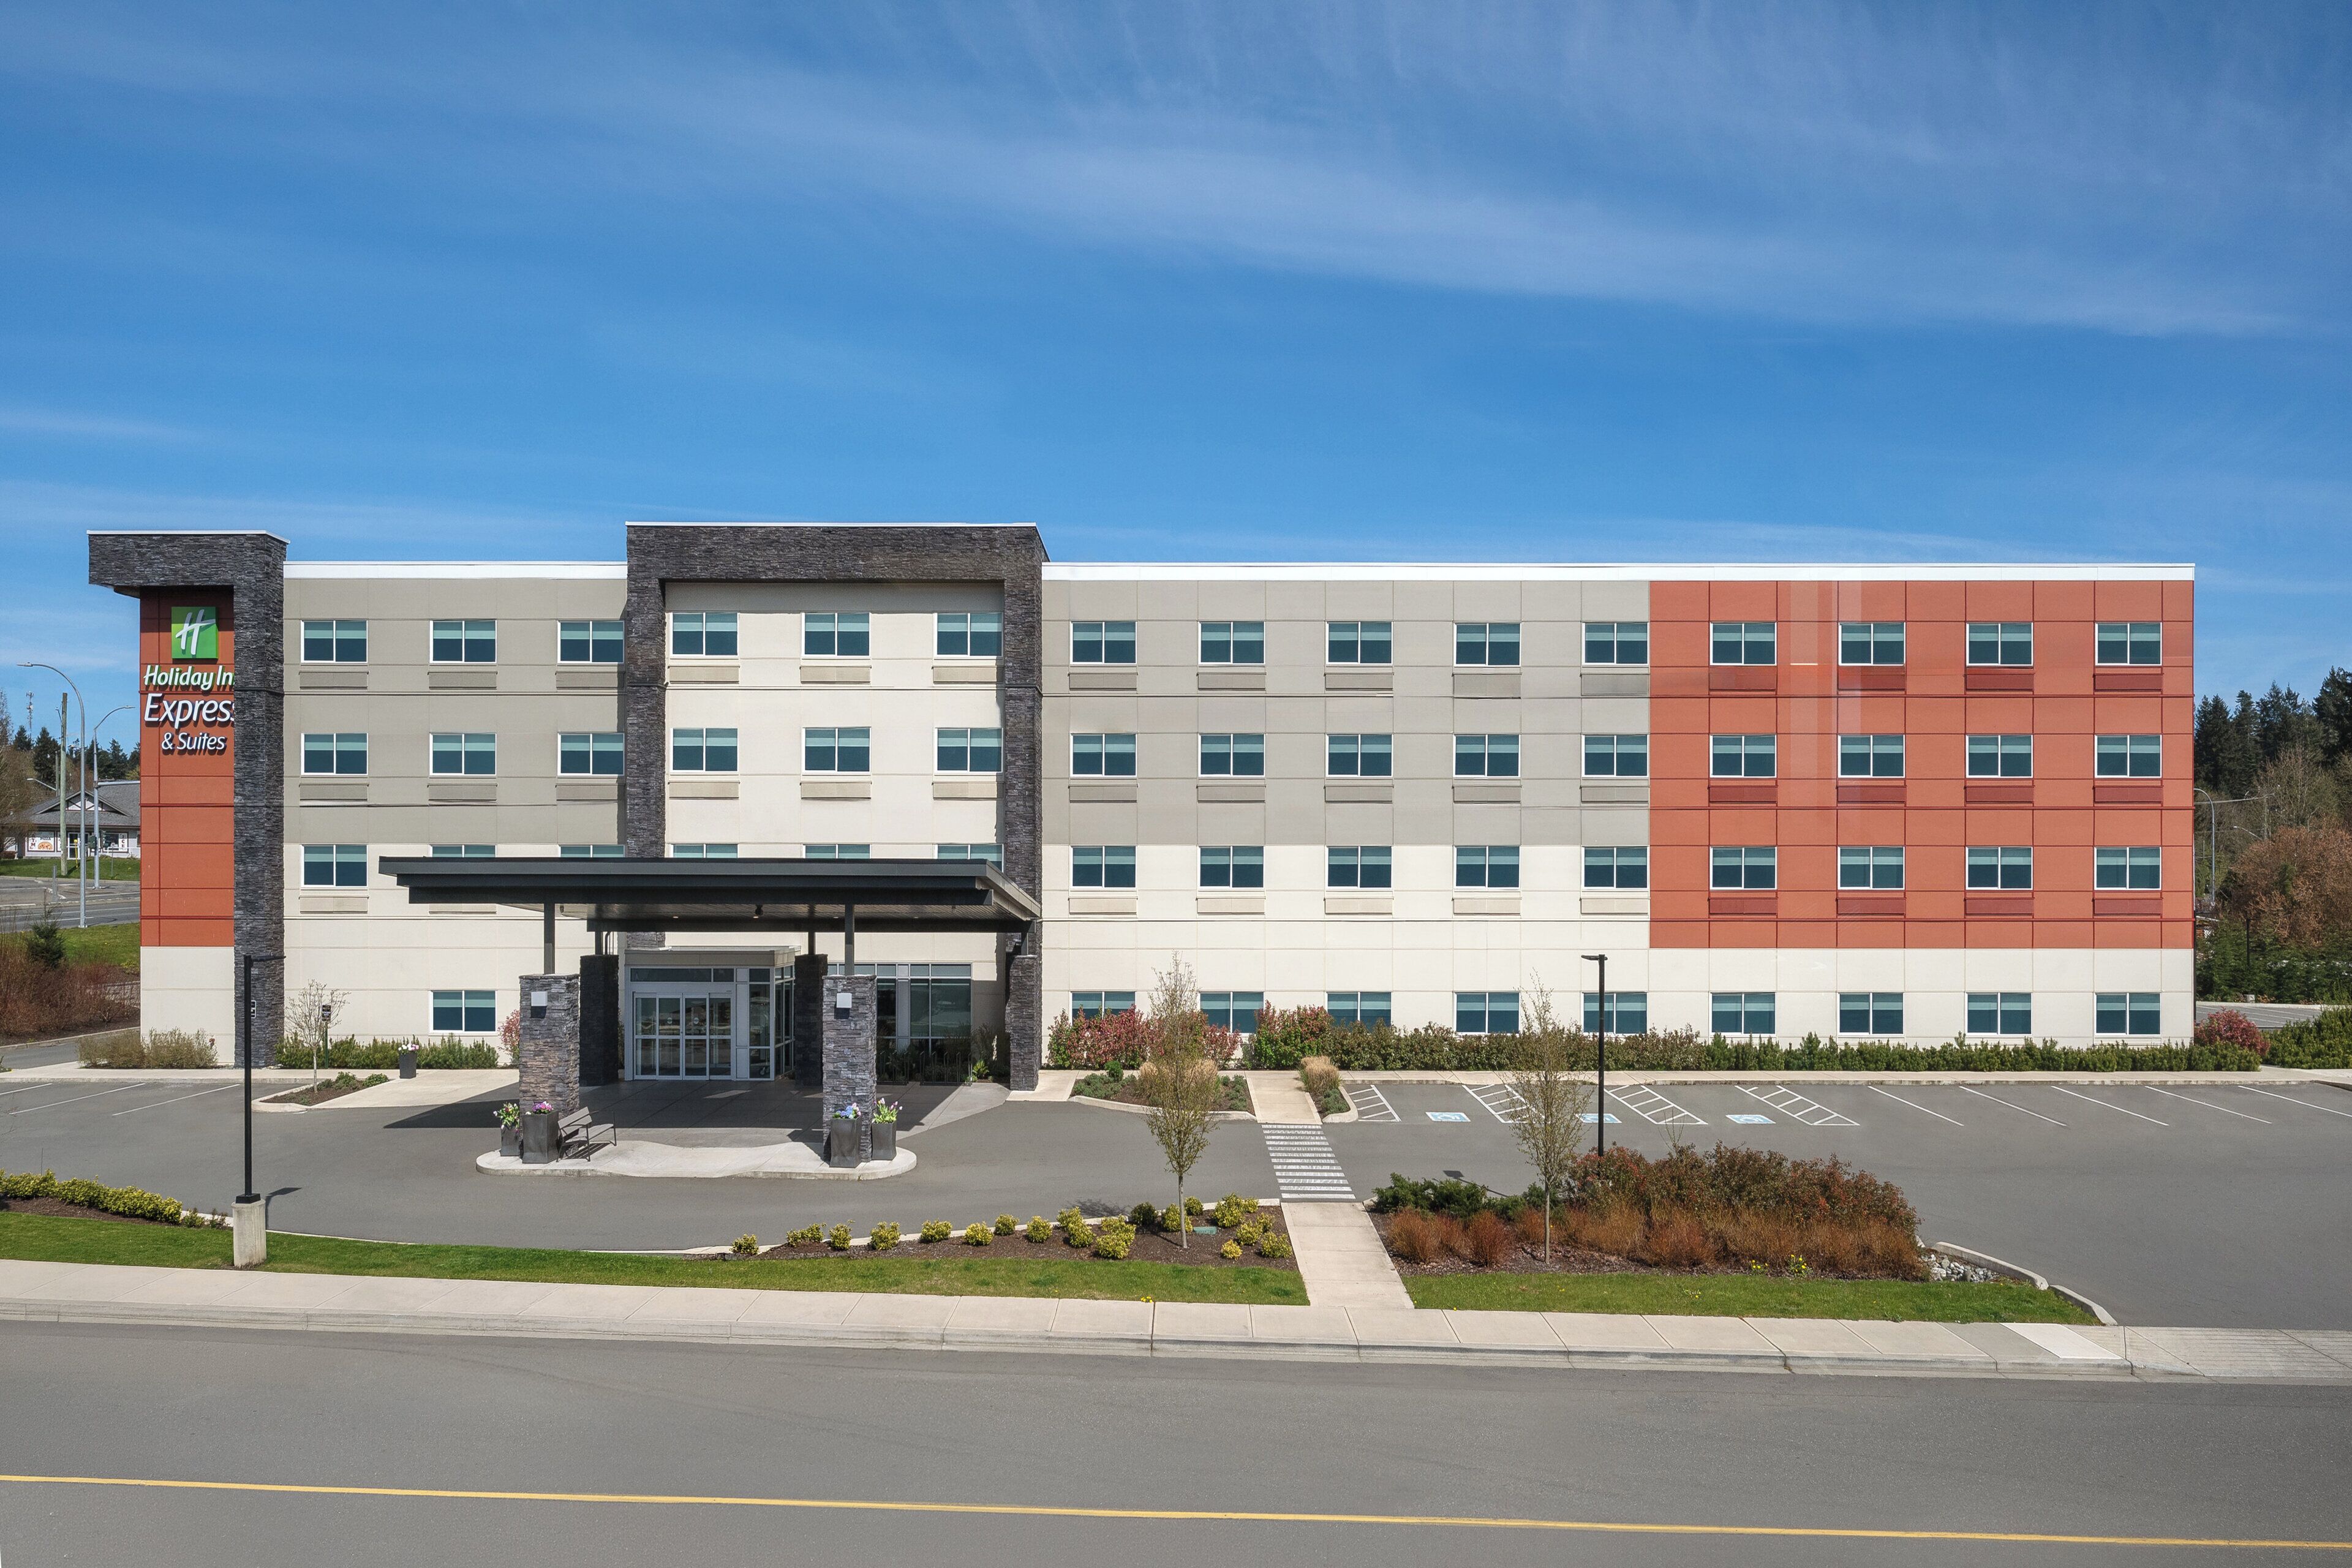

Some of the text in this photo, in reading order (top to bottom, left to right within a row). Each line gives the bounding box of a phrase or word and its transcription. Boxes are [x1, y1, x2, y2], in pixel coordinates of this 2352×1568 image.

[143, 665, 235, 690] Holiday In
[144, 693, 235, 729] Expres
[161, 732, 225, 750] & Suites
